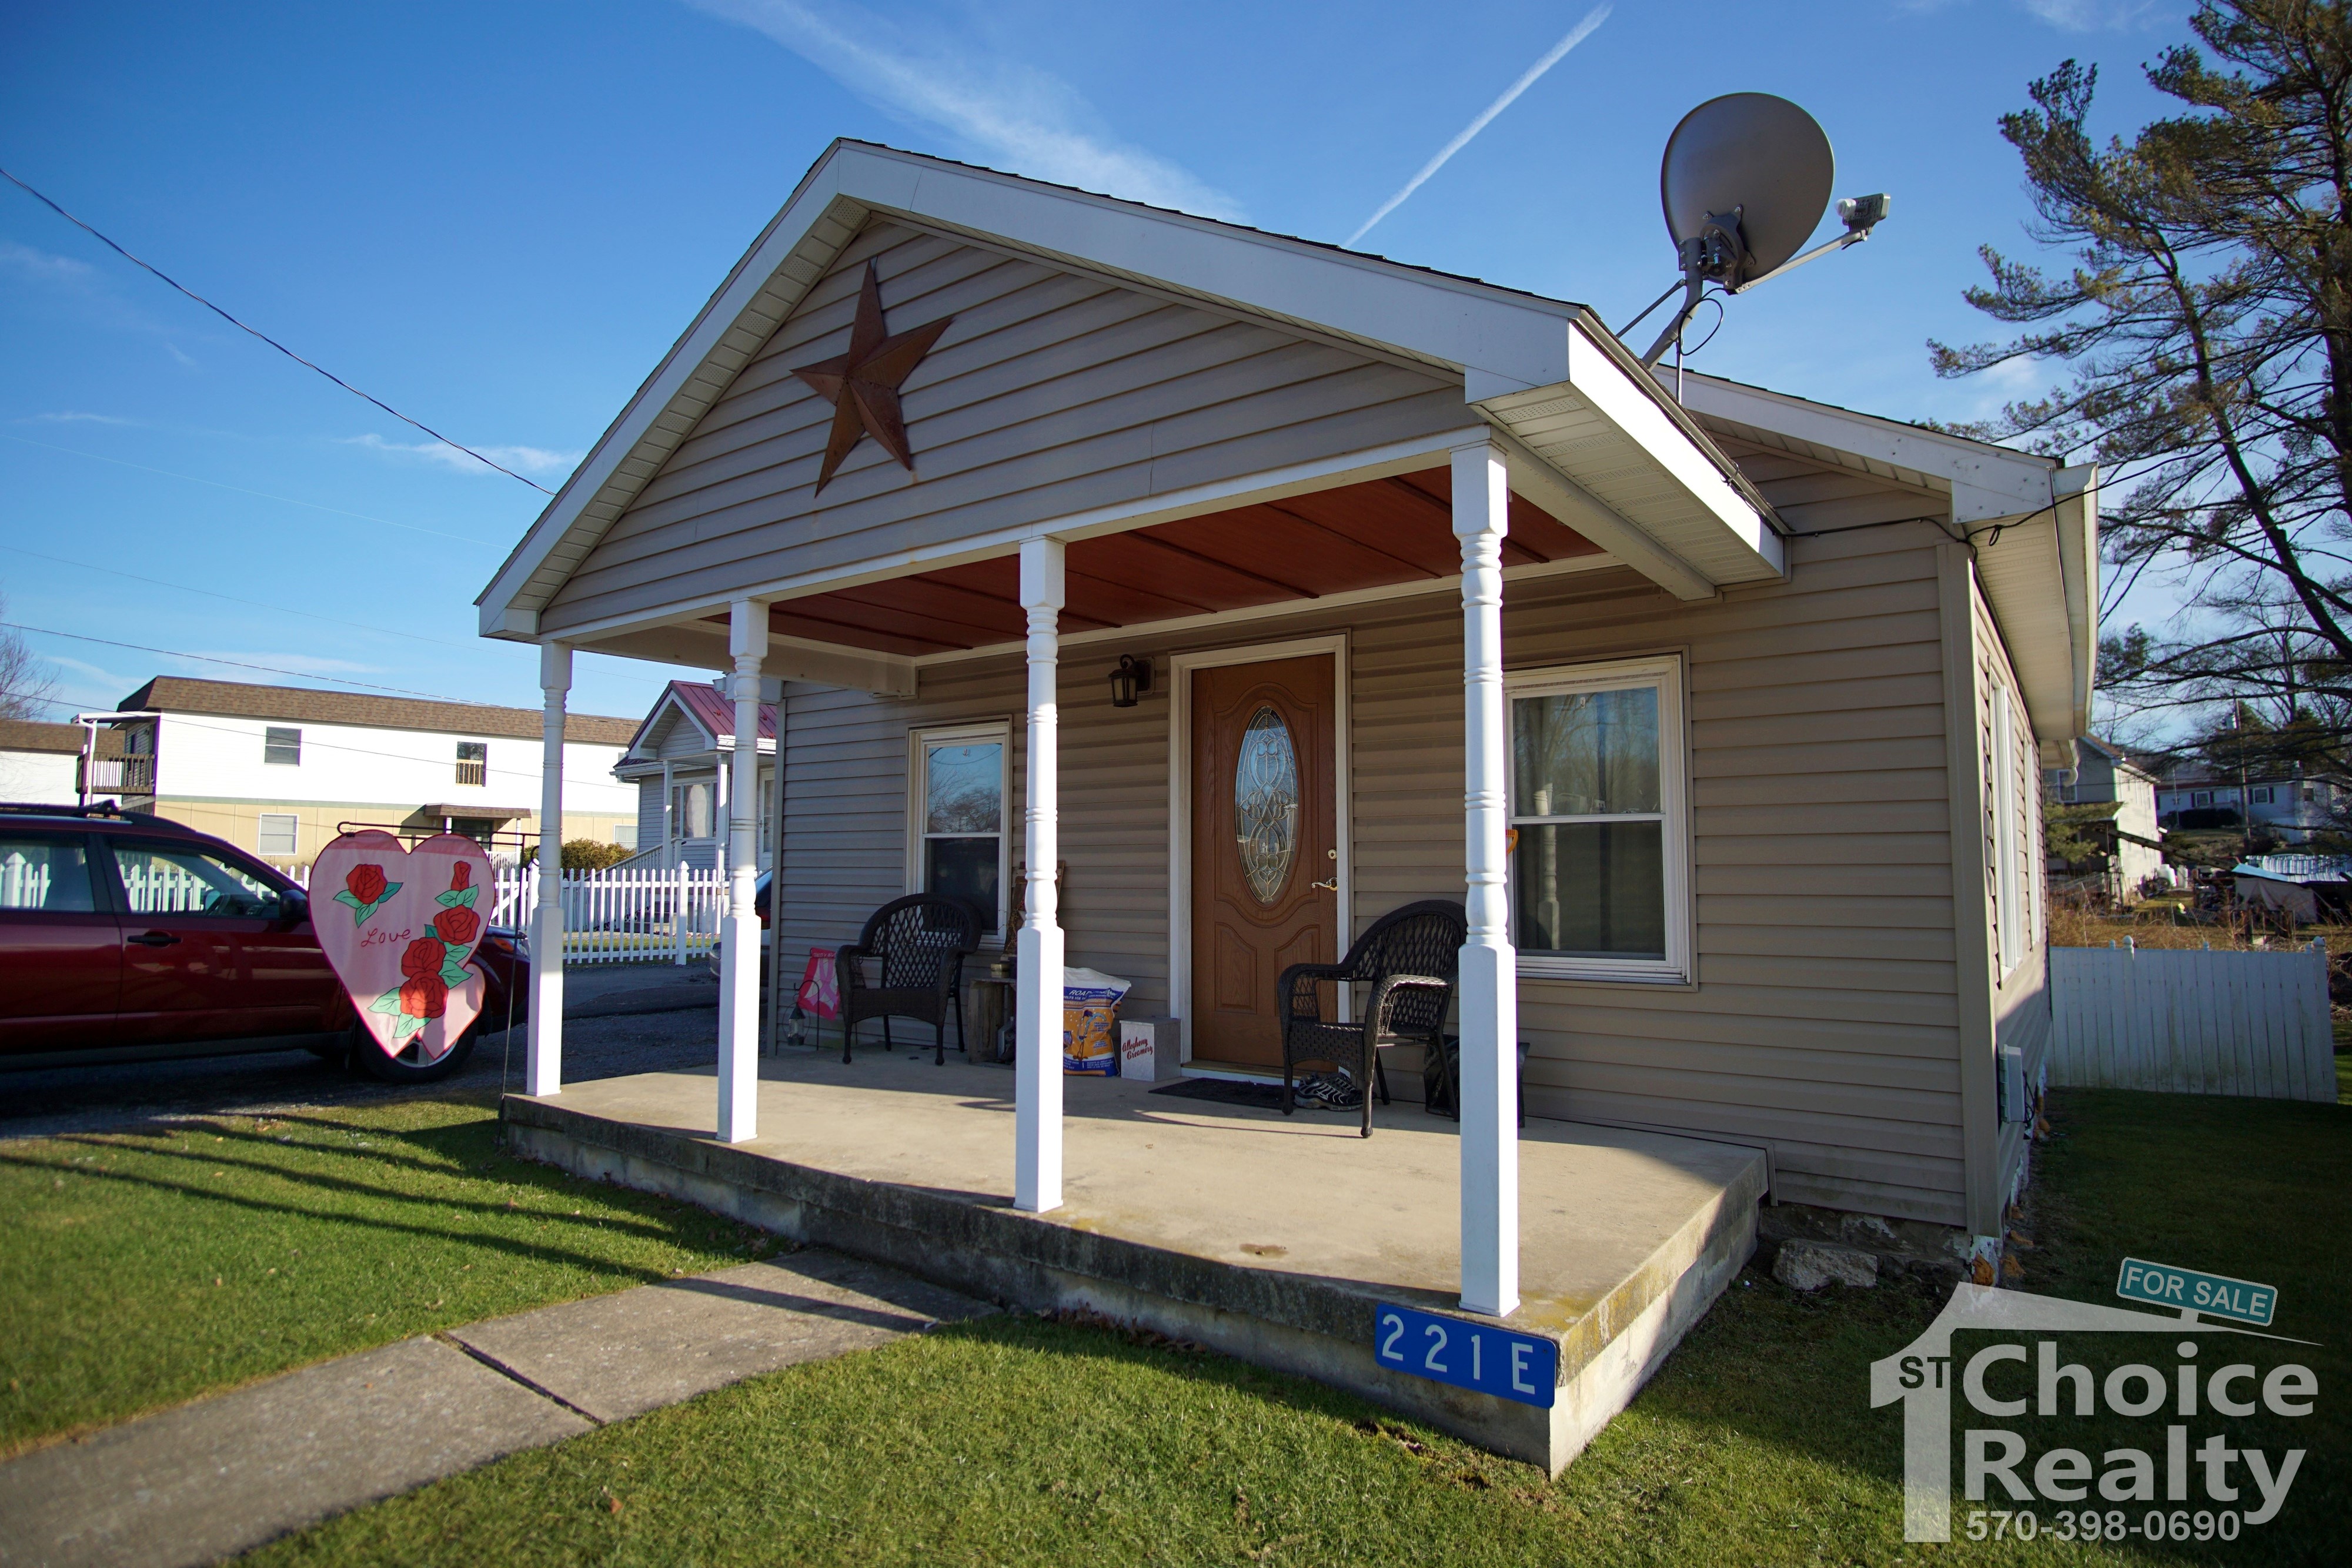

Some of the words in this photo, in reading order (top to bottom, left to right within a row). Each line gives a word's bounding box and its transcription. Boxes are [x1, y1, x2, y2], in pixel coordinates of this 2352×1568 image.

[360, 928, 412, 947] Love
[1122, 1036, 1148, 1052] Allegheny
[1127, 1046, 1153, 1060] Creamery
